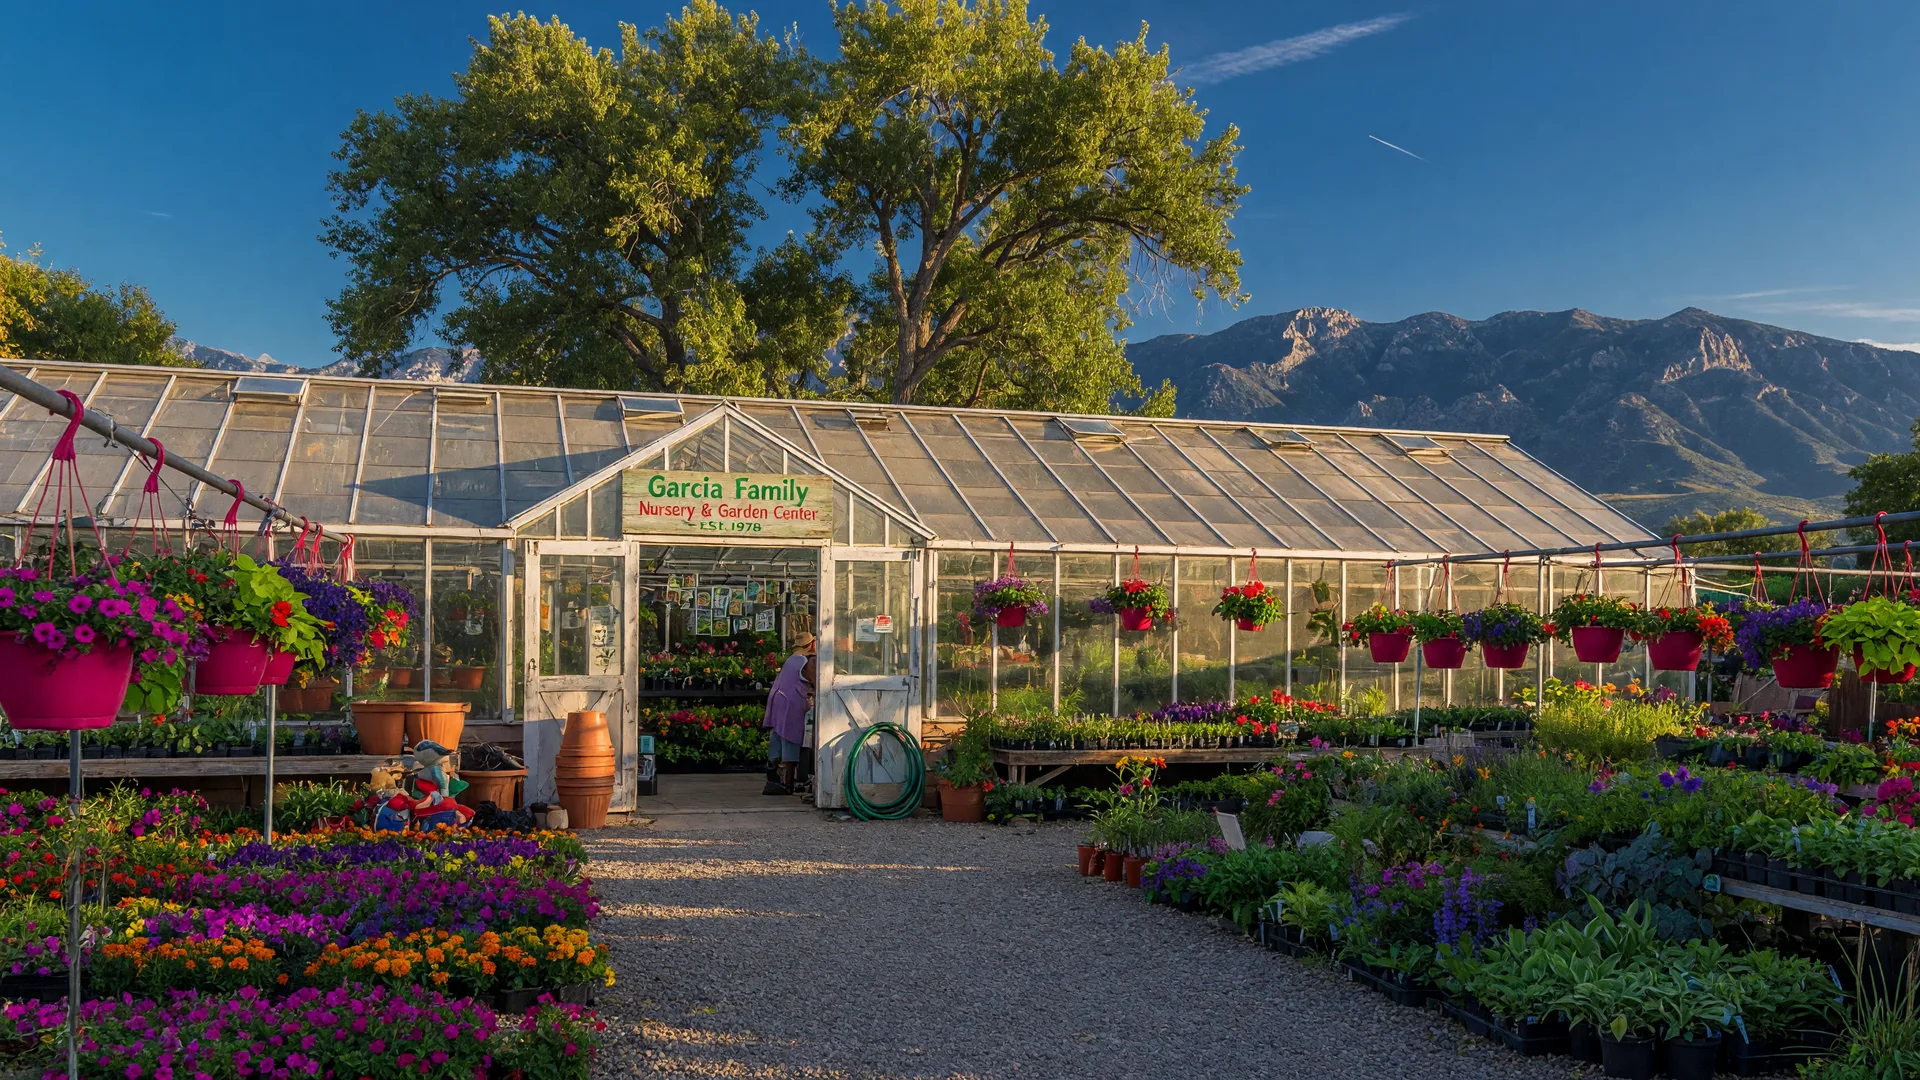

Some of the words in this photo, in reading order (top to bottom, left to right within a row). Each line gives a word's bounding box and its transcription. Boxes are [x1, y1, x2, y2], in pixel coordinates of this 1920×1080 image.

[648, 475, 723, 499] Garcia
[735, 477, 809, 507] Family
[639, 501, 696, 521] Nursery
[701, 503, 712, 518] &
[718, 504, 768, 520] Garden
[773, 505, 819, 521] Center
[731, 522, 761, 532] 1978
